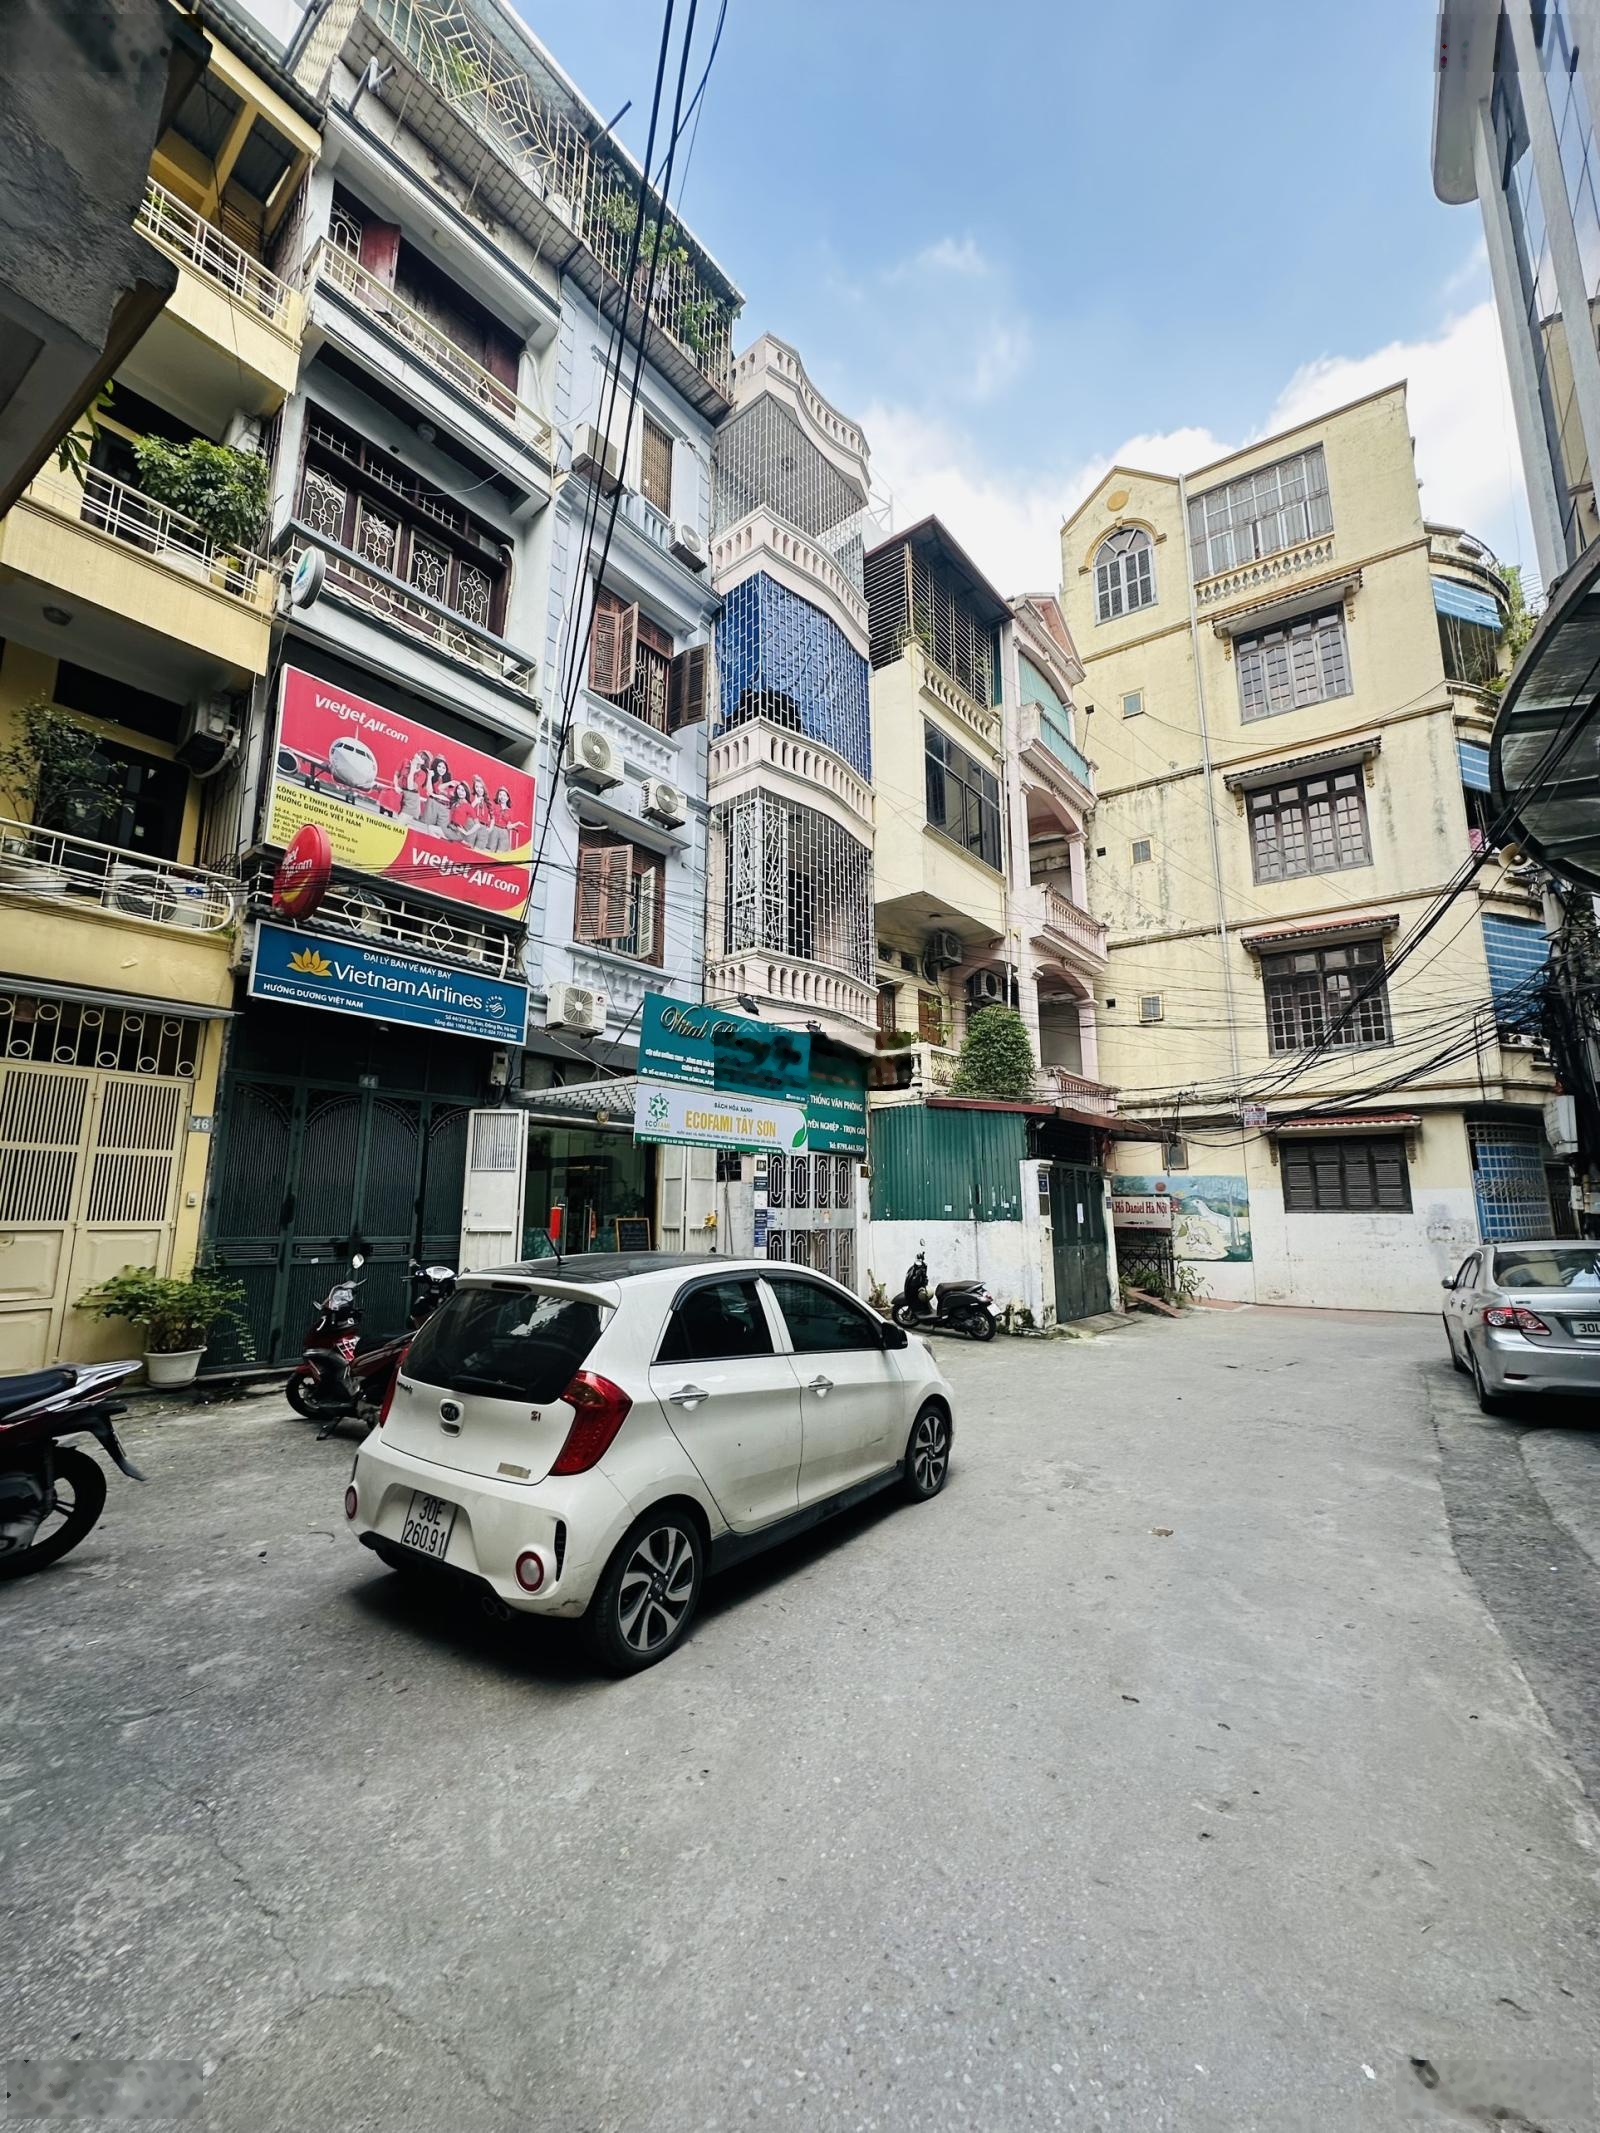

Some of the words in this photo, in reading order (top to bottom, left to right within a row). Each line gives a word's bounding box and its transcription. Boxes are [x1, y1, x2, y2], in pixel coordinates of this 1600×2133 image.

[309, 796, 328, 808] TNHH
[345, 817, 362, 828] NAM
[437, 970, 452, 980] BAY
[334, 961, 416, 996] Vietnam
[416, 981, 483, 1010] Airlines
[327, 995, 345, 1005] VIỆT
[345, 999, 364, 1008] NAM
[192, 1118, 209, 1130] 46
[685, 1110, 733, 1133] ECOFAMI
[419, 1497, 447, 1526] 30E
[404, 1519, 446, 1557] 260.91
